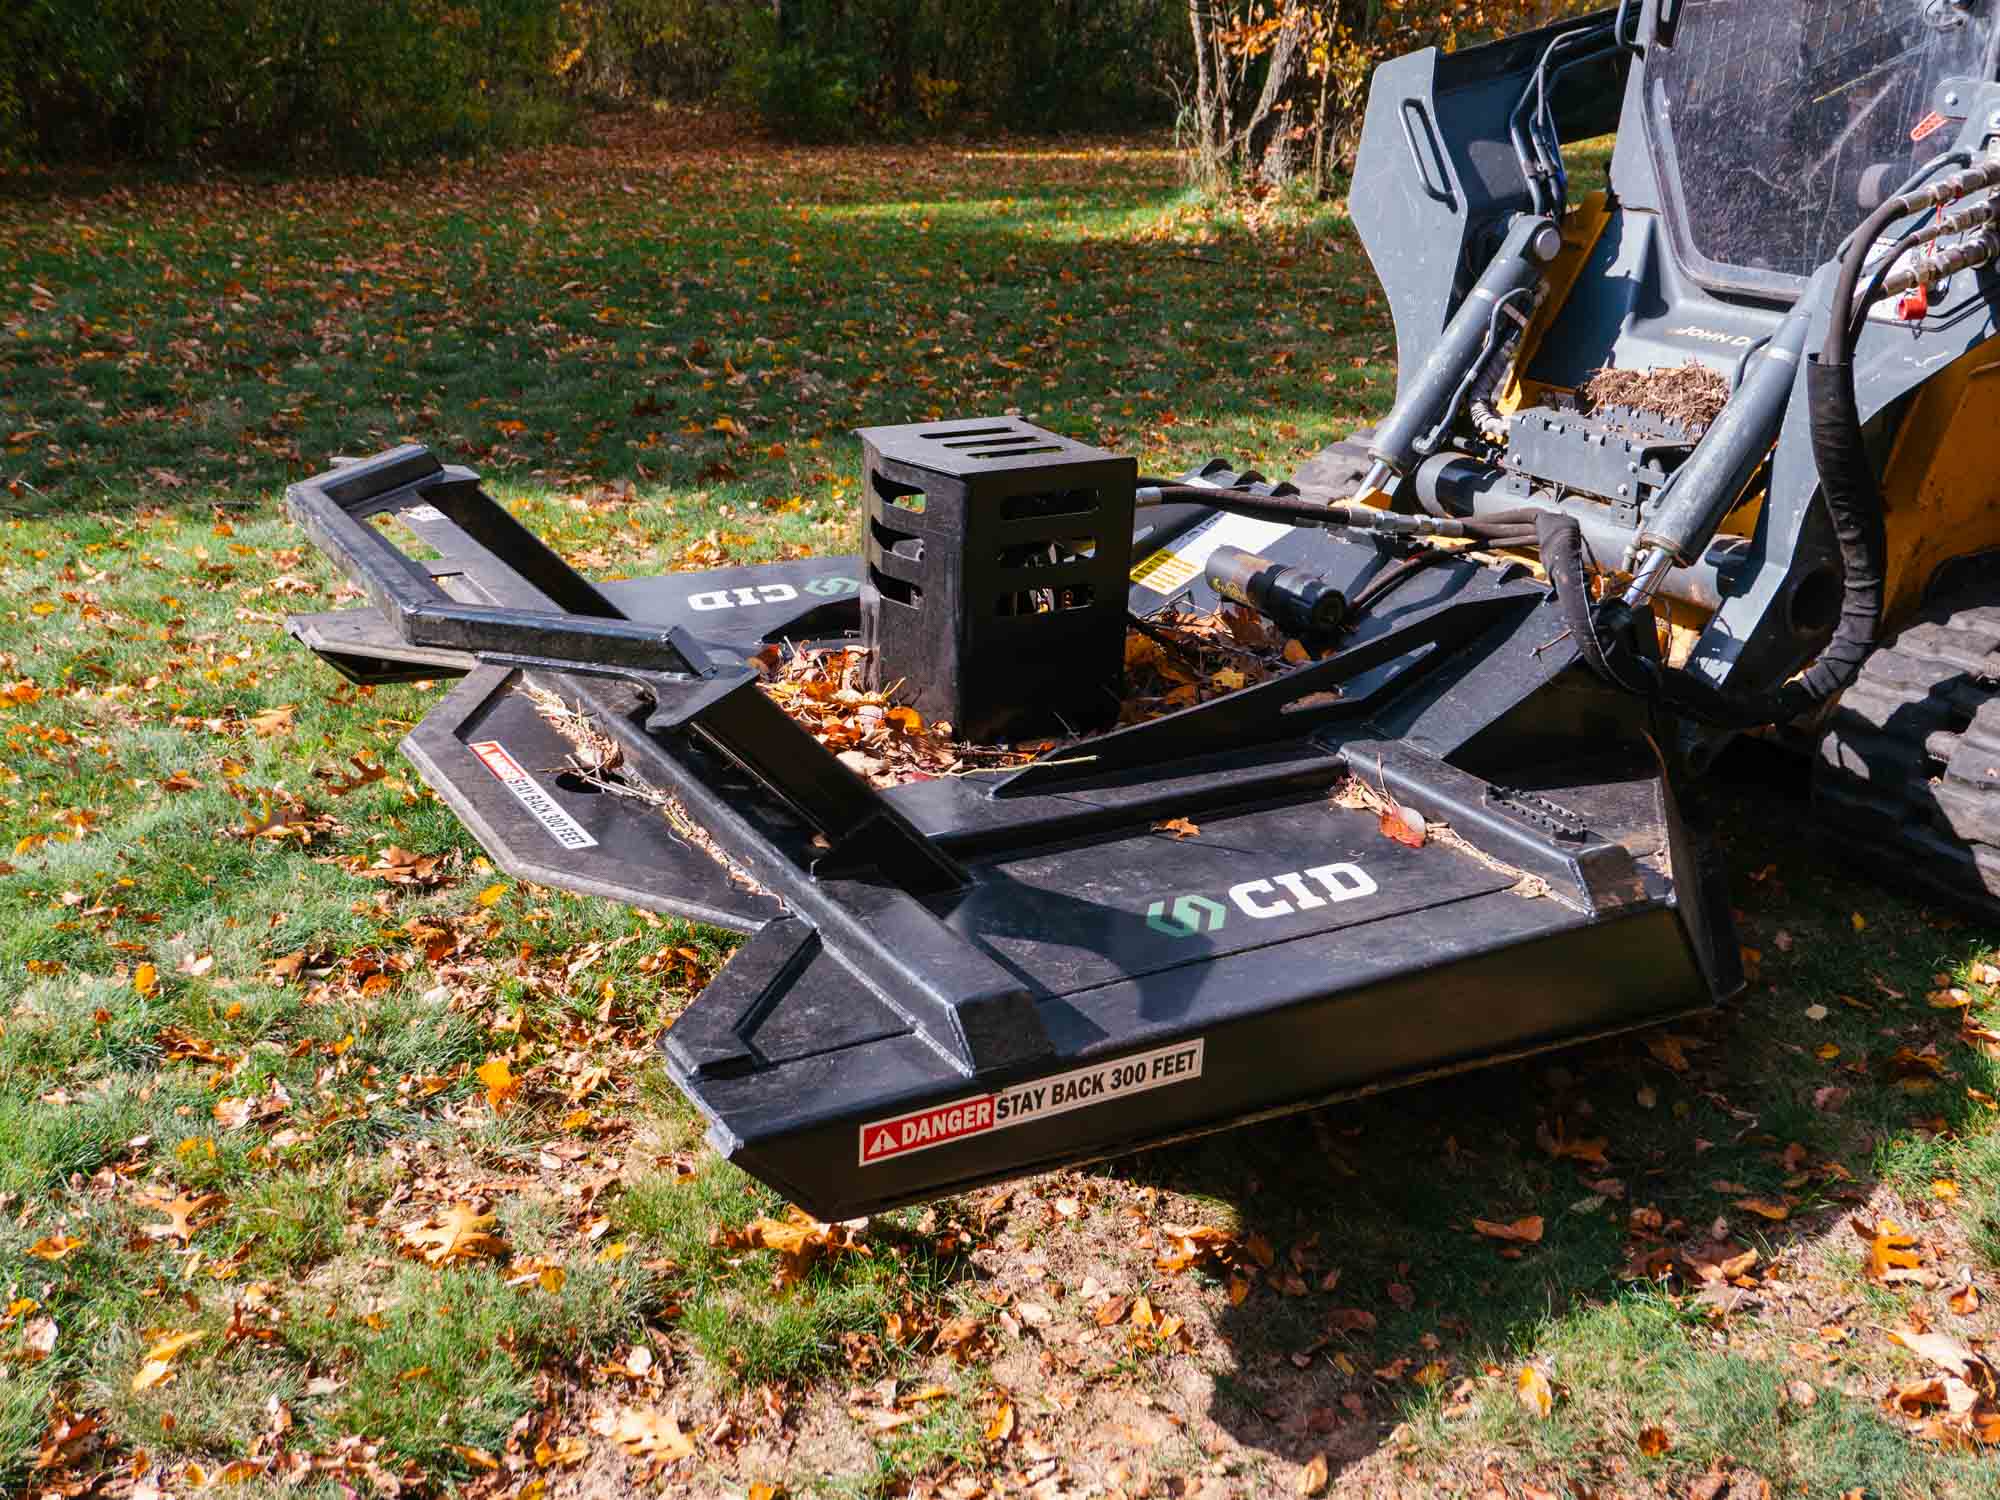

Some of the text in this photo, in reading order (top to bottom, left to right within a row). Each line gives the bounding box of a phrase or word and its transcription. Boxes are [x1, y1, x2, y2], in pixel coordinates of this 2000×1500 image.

[1676, 326, 1730, 343] JOHN
[687, 583, 799, 611] CID
[507, 779, 587, 845] STAY BACK 300 FEET
[1228, 862, 1378, 919] CID
[901, 1049, 1198, 1146] DANGER STAY BACK 300 FEET
